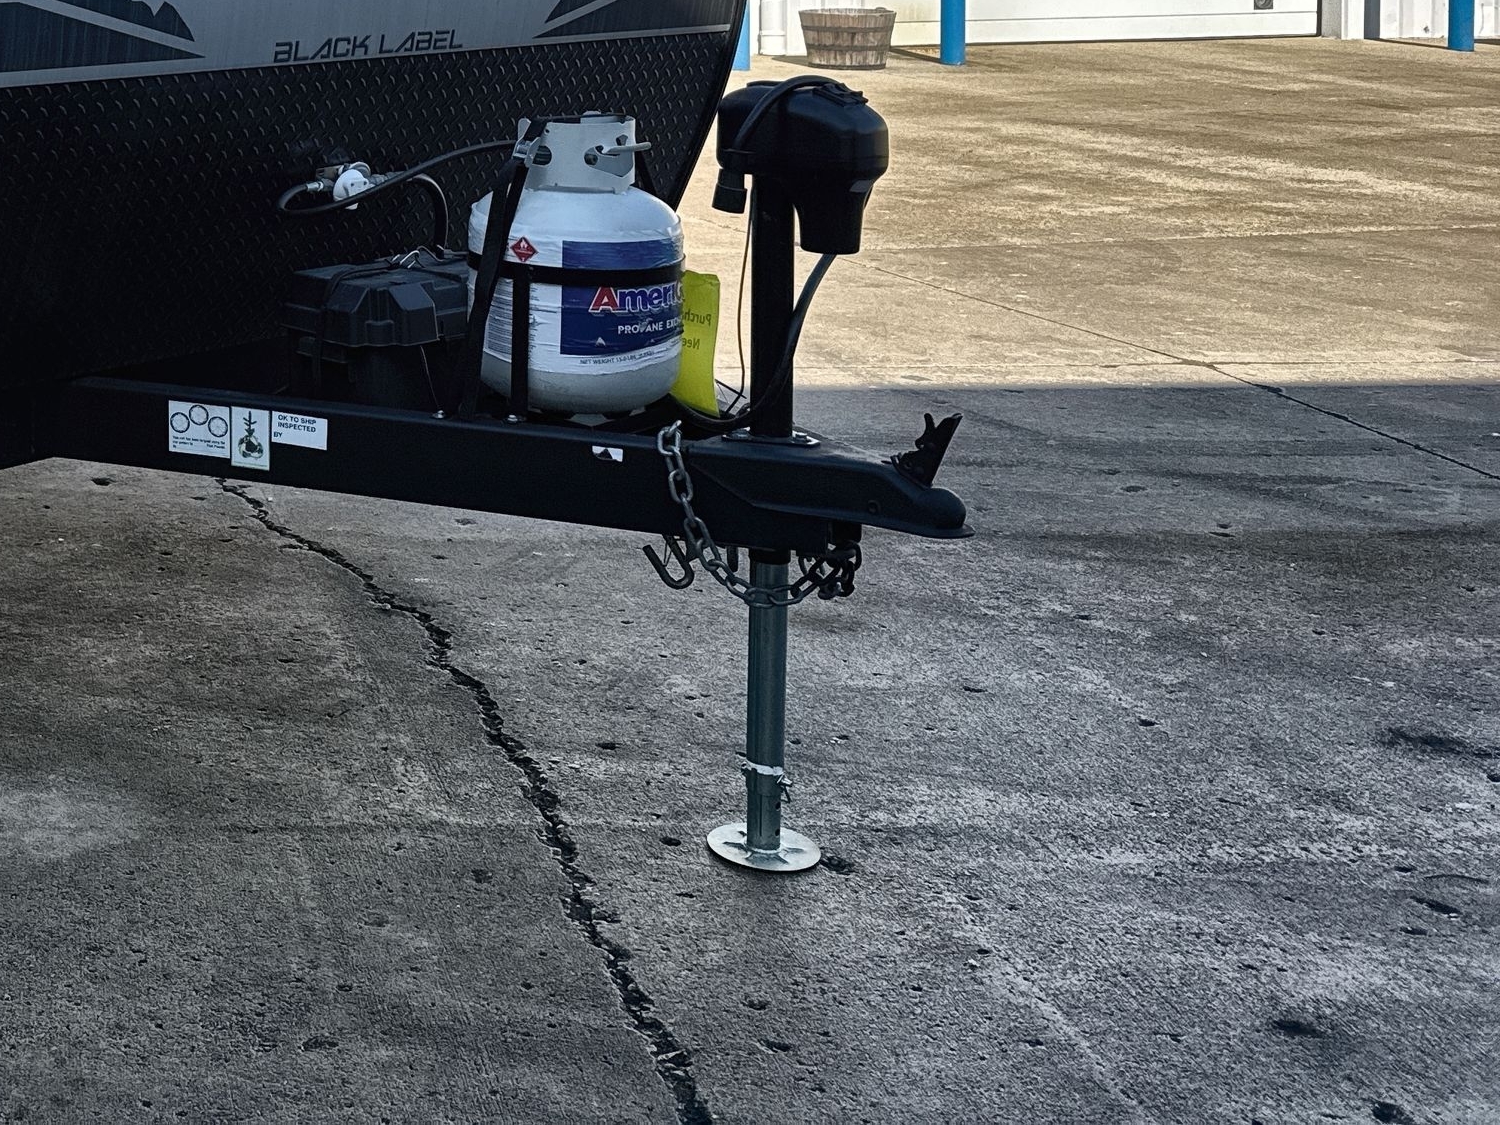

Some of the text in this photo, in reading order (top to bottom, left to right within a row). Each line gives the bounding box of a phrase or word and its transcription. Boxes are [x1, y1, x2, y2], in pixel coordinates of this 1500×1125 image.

[273, 29, 463, 63] BLACK LABEL
[277, 414, 289, 422] OK
[277, 422, 317, 433] INSPECTED
